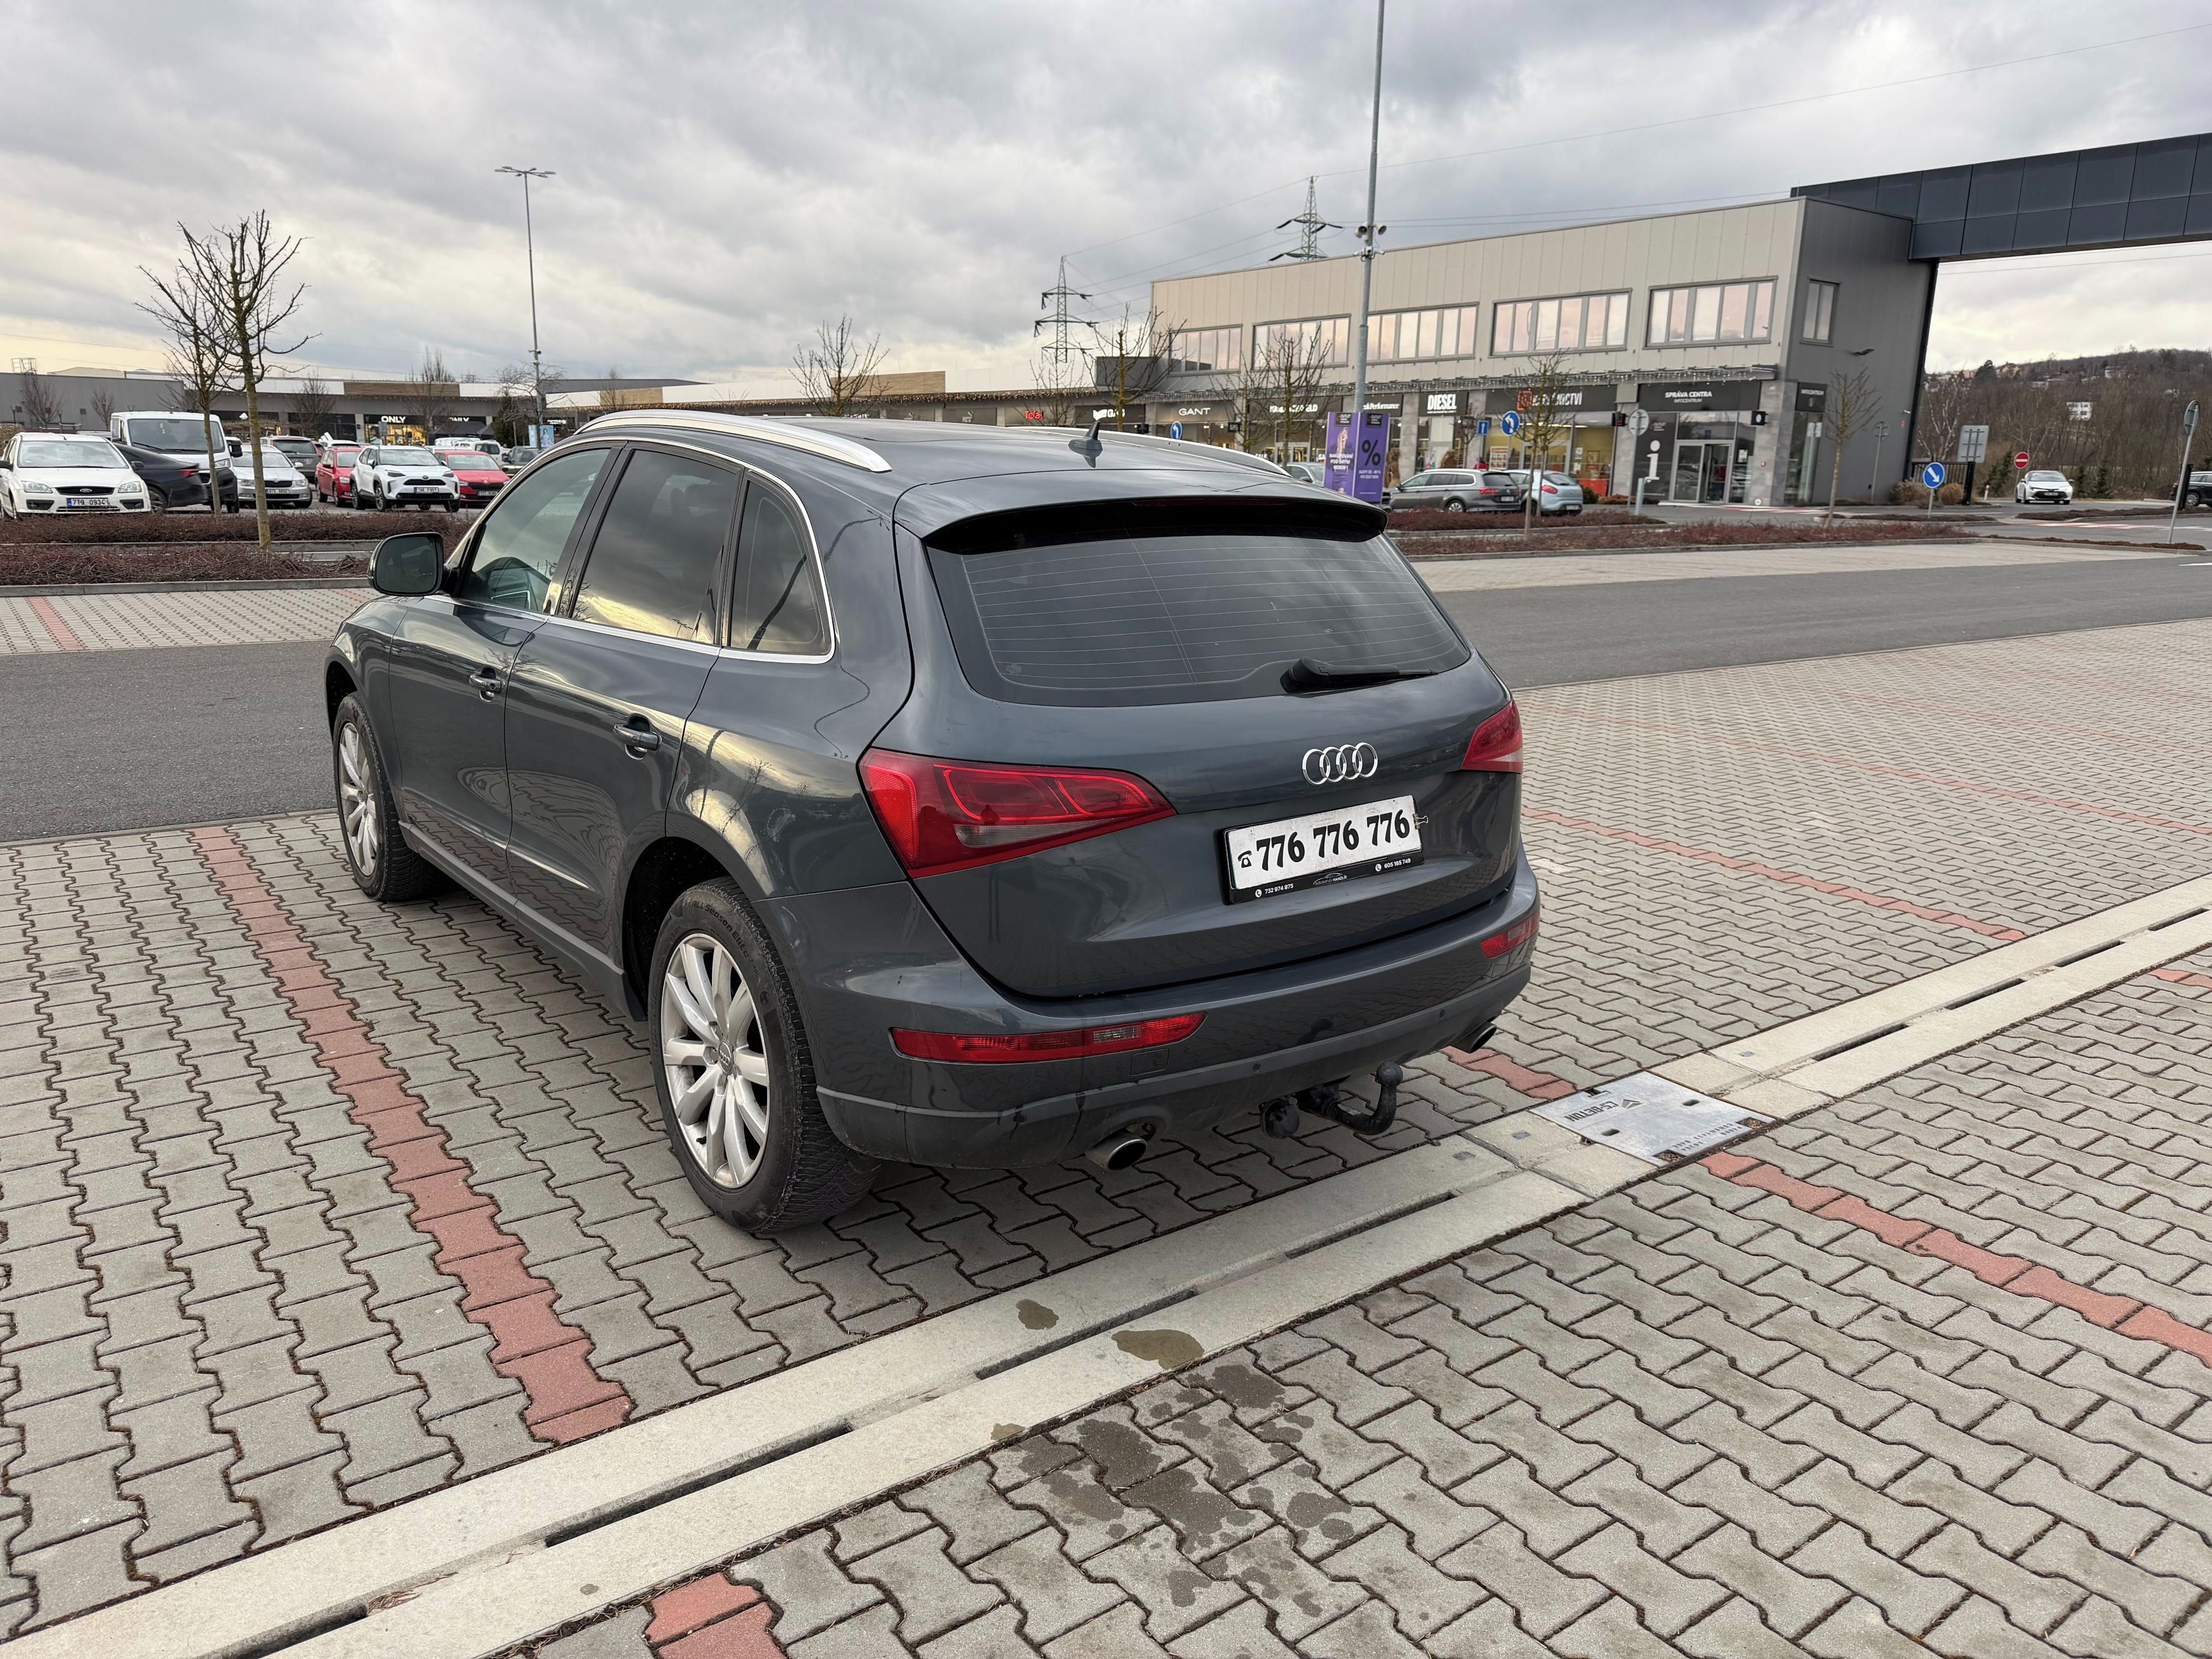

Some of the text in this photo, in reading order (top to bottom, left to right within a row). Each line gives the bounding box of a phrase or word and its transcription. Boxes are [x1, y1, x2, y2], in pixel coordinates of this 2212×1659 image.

[1427, 394, 1456, 410] DIESEL
[1256, 810, 1411, 872] 776 776 776
